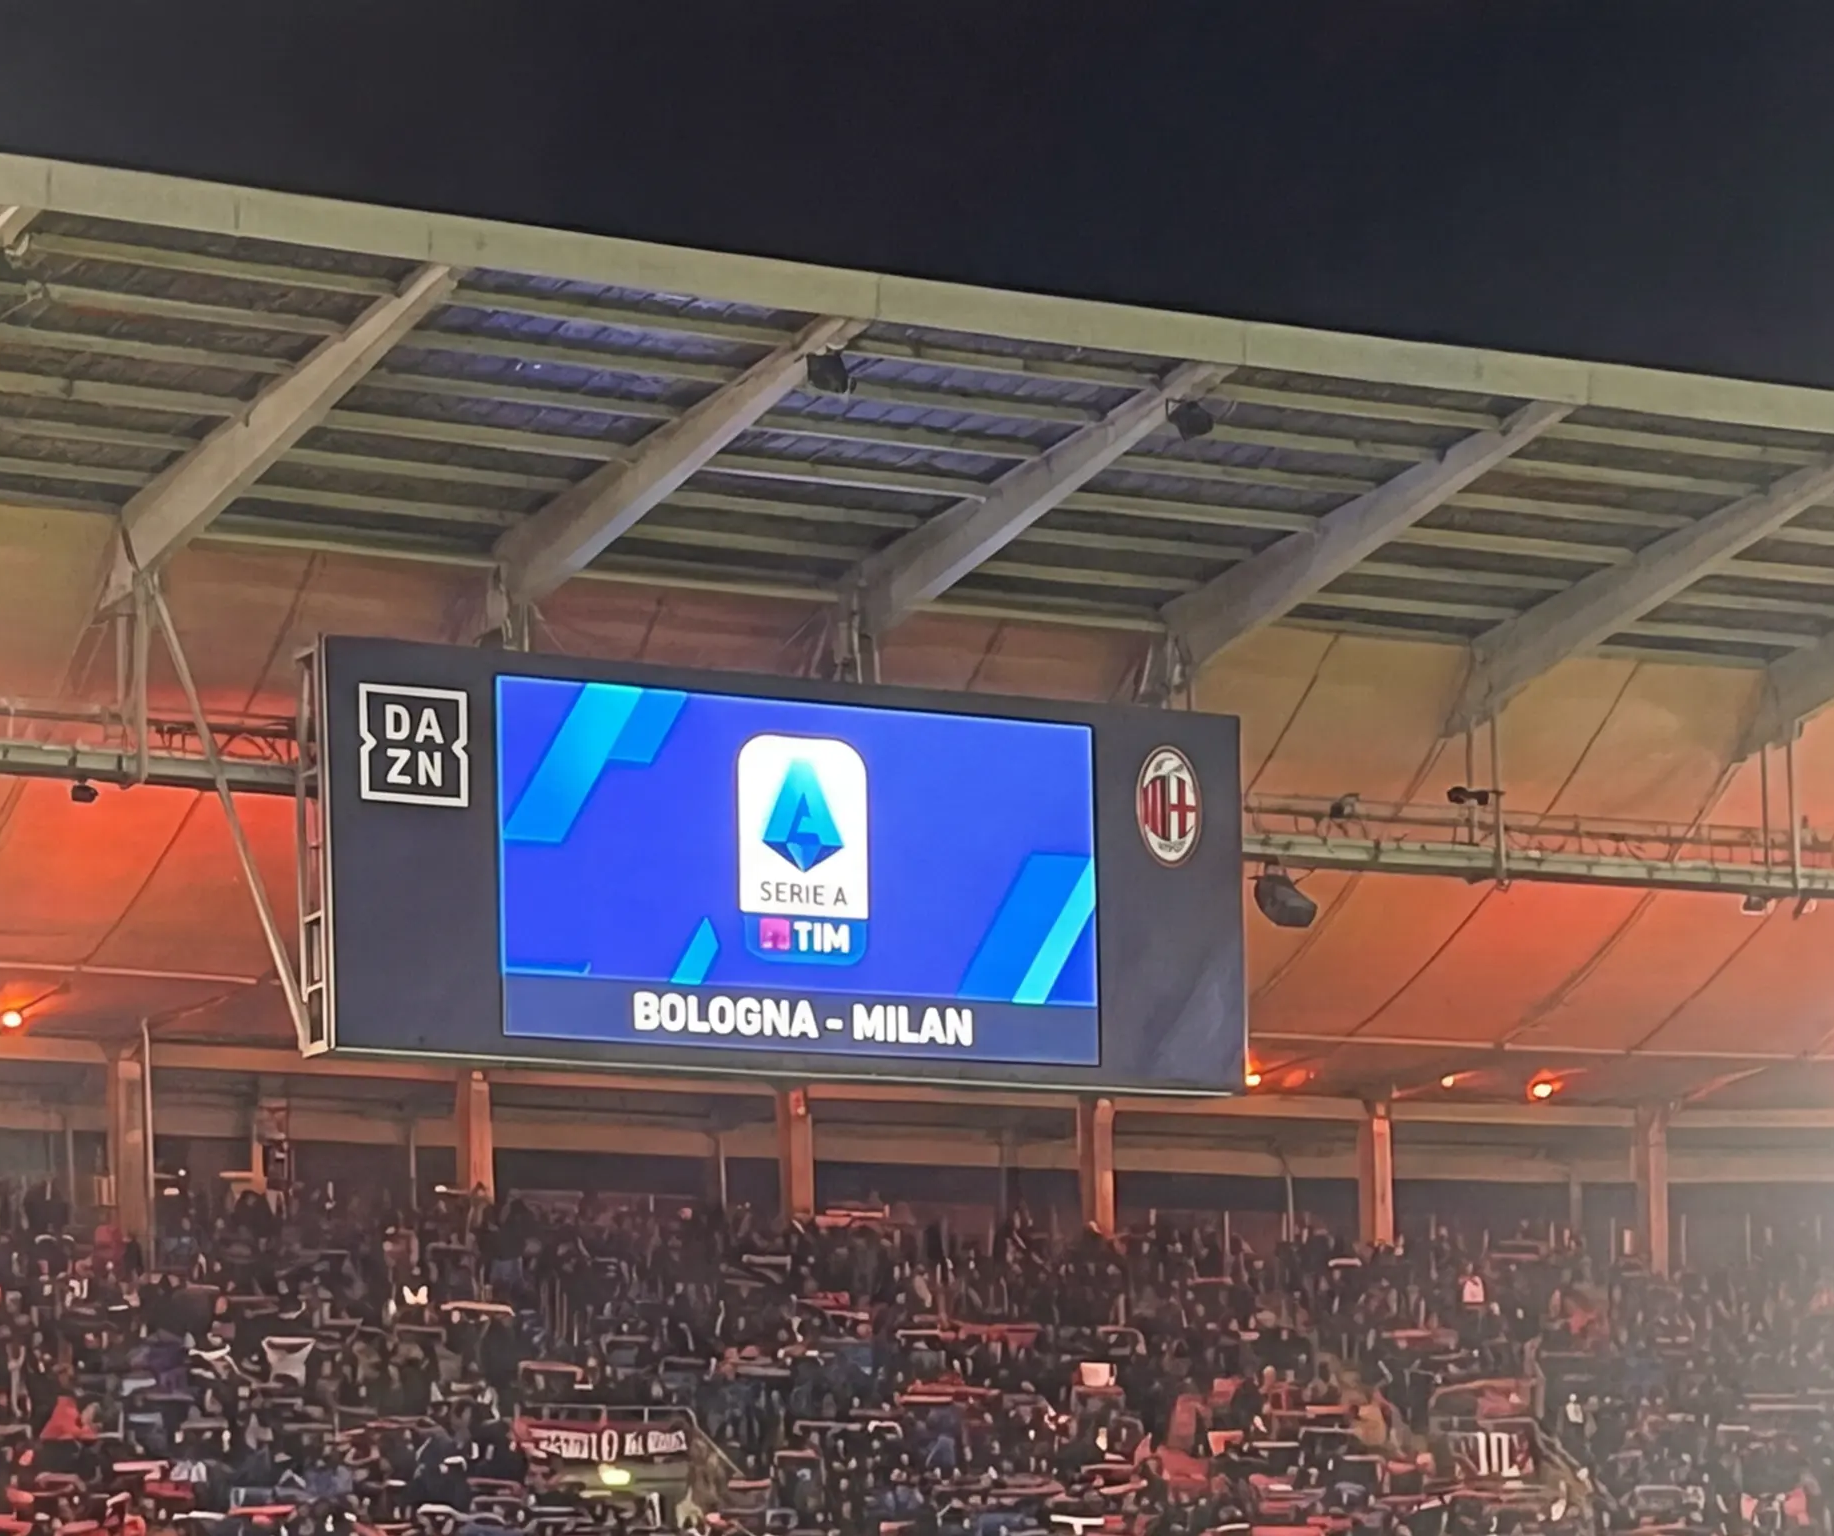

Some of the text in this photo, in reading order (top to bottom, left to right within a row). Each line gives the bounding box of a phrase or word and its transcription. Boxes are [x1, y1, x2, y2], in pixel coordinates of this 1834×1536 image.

[760, 881, 848, 906] SERIE A
[793, 920, 850, 954] TIM
[633, 990, 820, 1039] BOLOGNA
[853, 1003, 974, 1047] MILAN
